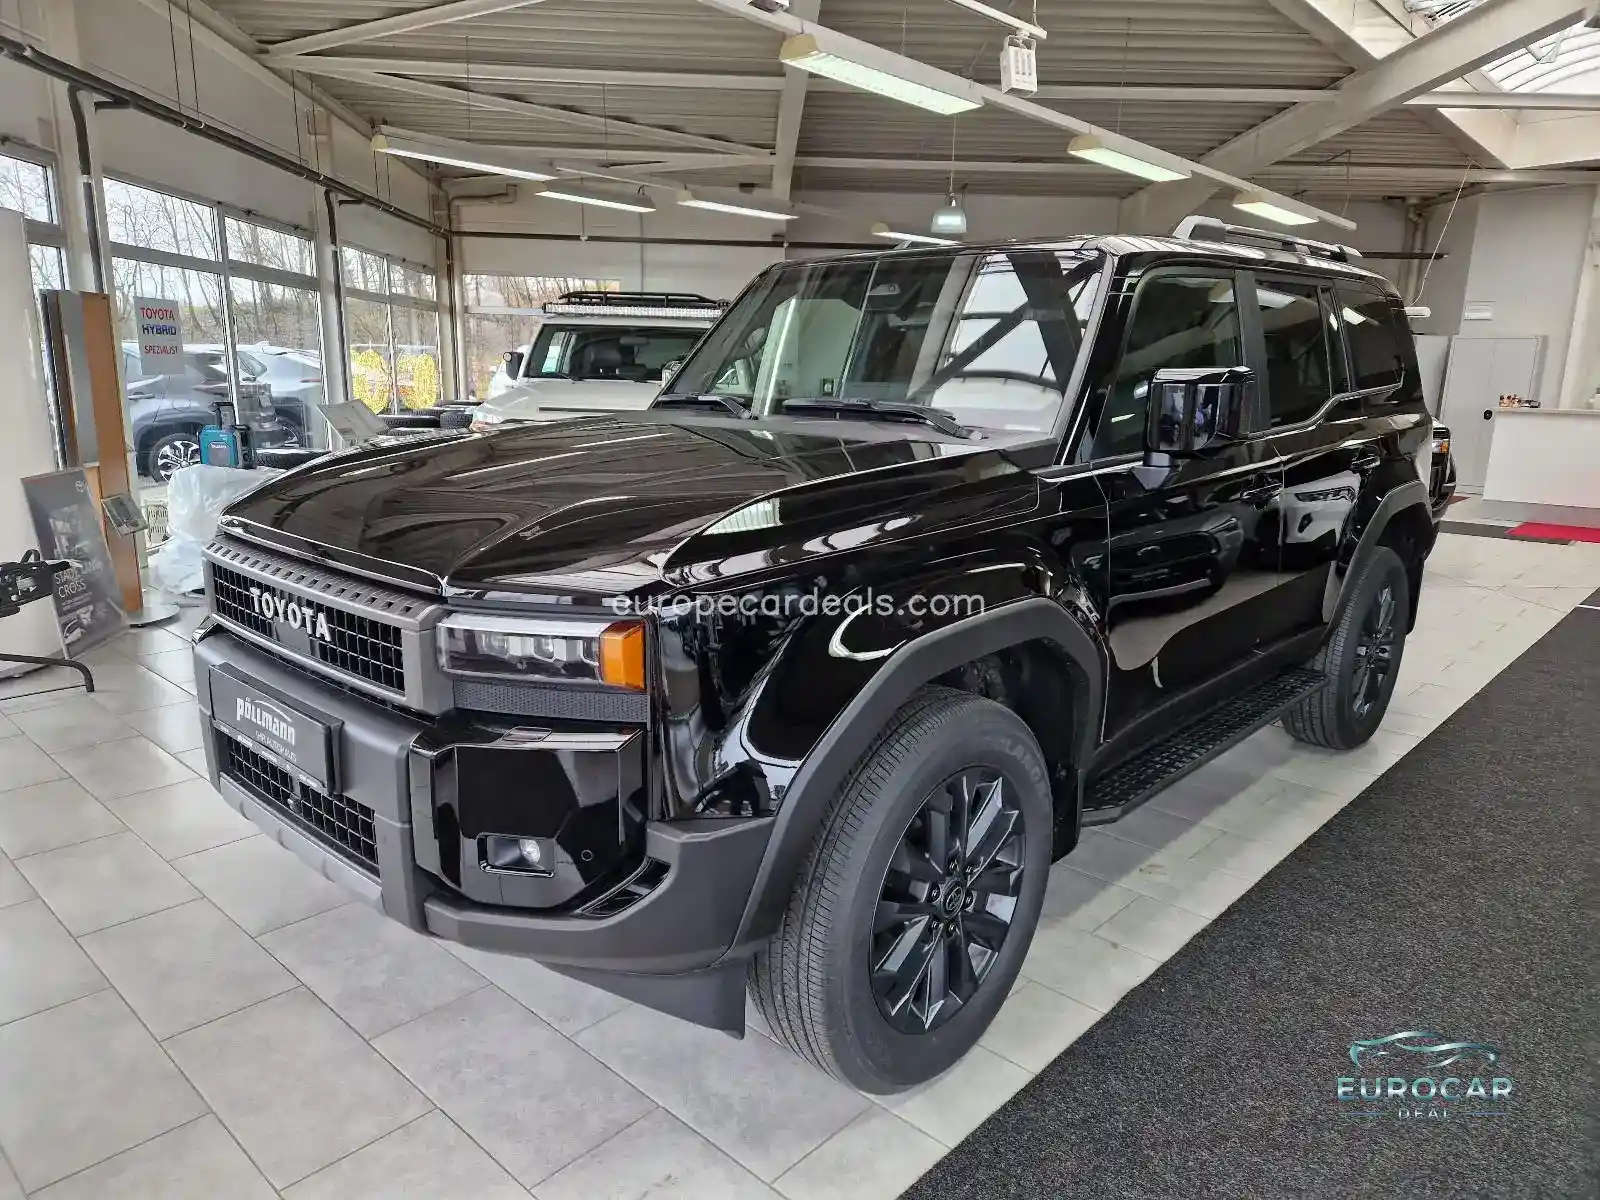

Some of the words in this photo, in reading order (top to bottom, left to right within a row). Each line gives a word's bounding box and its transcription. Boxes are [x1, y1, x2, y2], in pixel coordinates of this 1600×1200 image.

[140, 307, 175, 321] TOYOTA
[142, 324, 177, 336] HYBRID
[144, 345, 178, 355] SPEZIALIST
[58, 580, 86, 598] CROSS
[250, 587, 331, 642] TOYOTA
